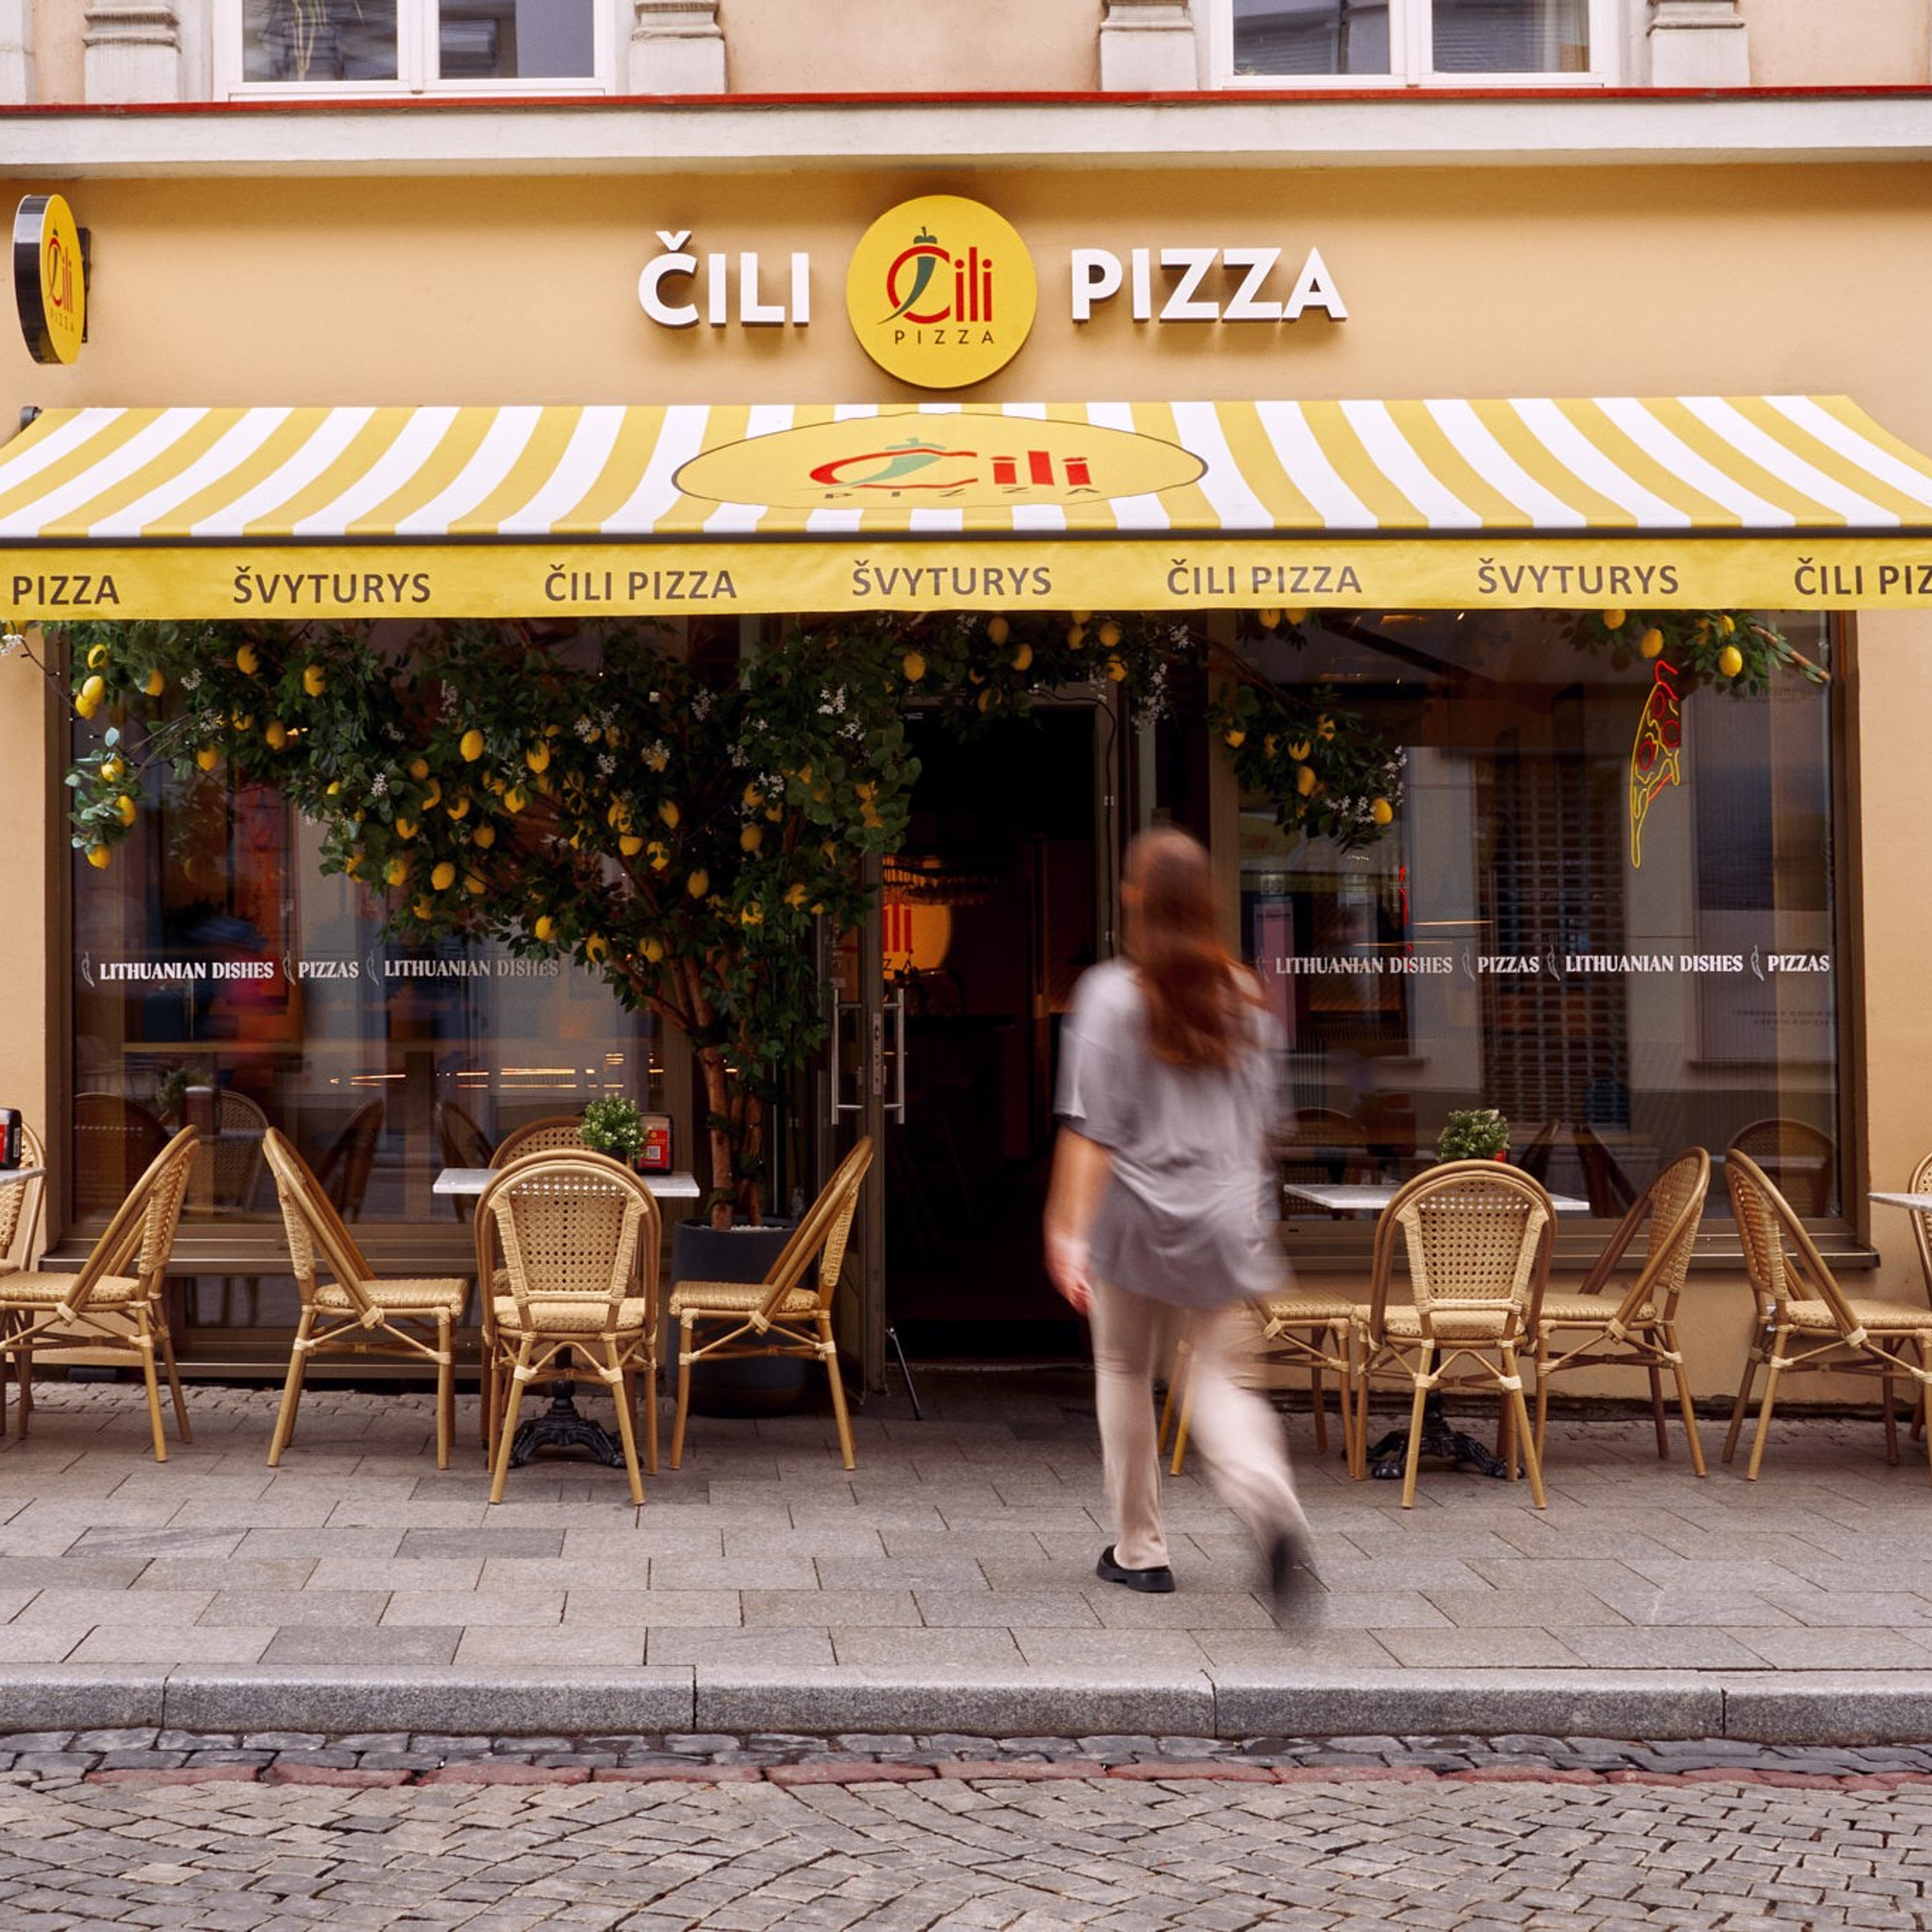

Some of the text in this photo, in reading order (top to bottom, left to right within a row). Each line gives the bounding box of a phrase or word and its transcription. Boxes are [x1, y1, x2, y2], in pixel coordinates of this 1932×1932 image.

[638, 230, 1349, 326] ČILI PIZZA
[895, 330, 995, 345] PIZZA
[824, 485, 1102, 499] PIZZA
[12, 574, 121, 605] PIZZA
[233, 566, 431, 604] ŠVYTURYS
[545, 564, 612, 601] ČILI
[629, 570, 737, 601] PIZZA
[852, 560, 1051, 597] ŠVYTURYS
[1168, 559, 1235, 595] ČILI
[1252, 566, 1362, 595] PIZZA
[1478, 558, 1679, 595] ŠVYTURYS
[1794, 557, 1863, 595] ČILI
[100, 960, 559, 980] LITHUANIAN DISHES PIZZAS LITHUANIAN DISHES
[1275, 955, 1830, 974] LITHUANIAN DISHES PIZZAS LITHUANIAN DISHES PIZZAS
